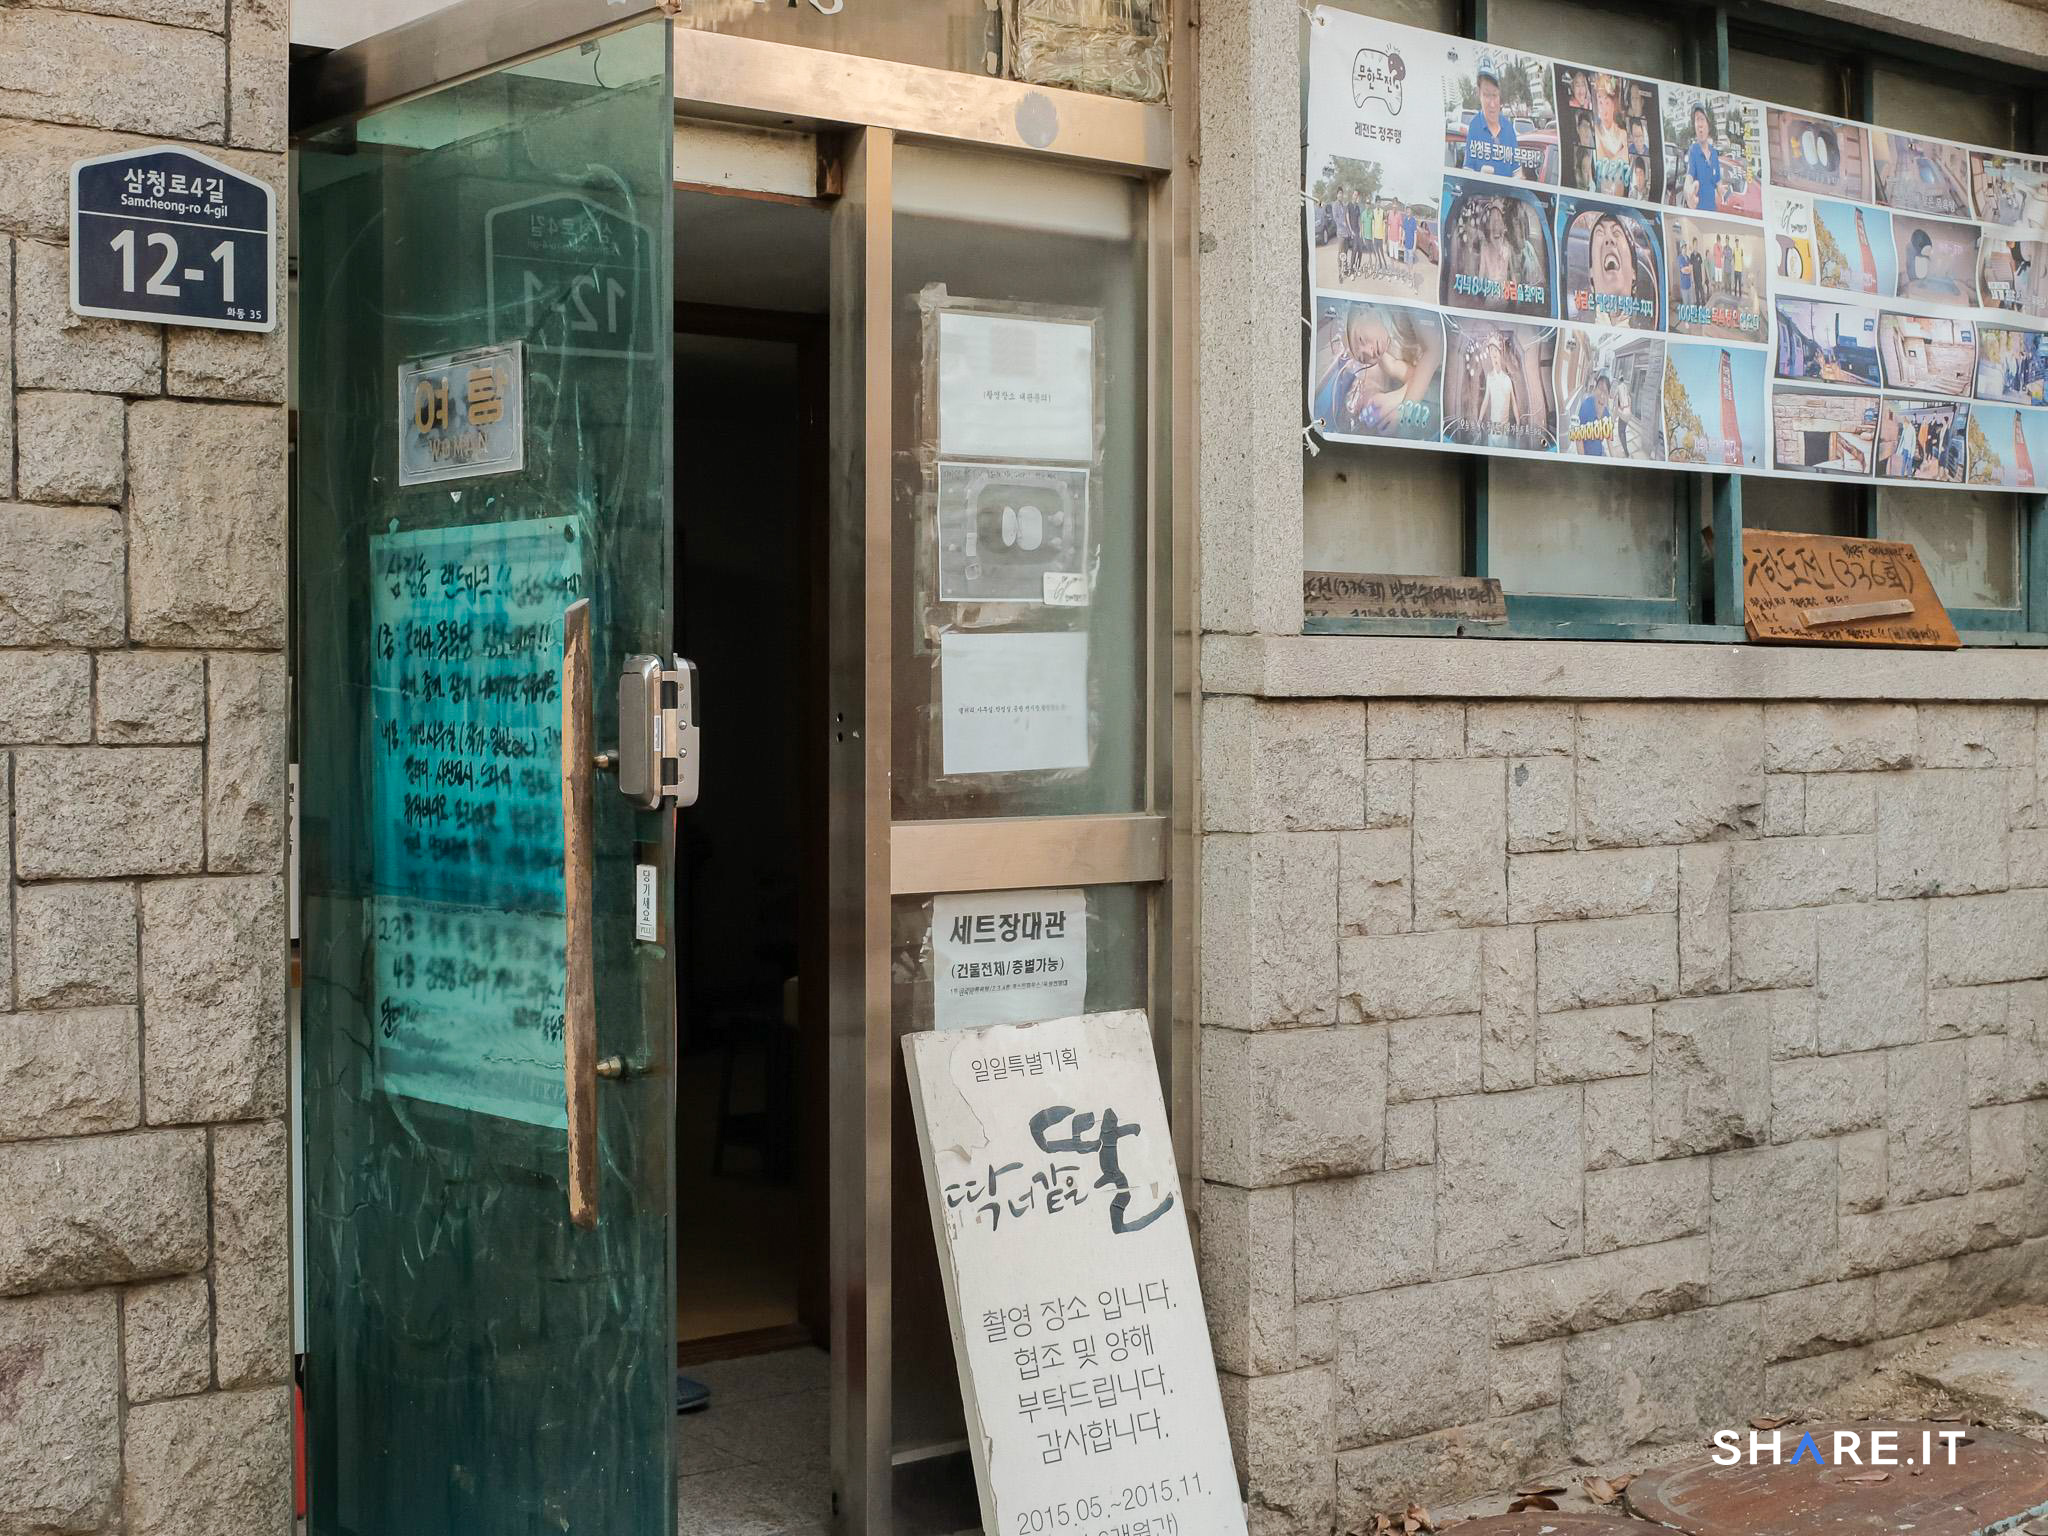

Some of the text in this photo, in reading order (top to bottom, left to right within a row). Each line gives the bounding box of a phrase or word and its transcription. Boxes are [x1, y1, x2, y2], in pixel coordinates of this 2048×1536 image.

[1354, 121, 1402, 145] 레전드 정주행
[1492, 145, 1513, 165] 코리아
[123, 168, 224, 204] 삼청로4길
[120, 193, 229, 218] Samcheong-ro 4-gil
[109, 229, 236, 303] 12-1
[226, 307, 262, 320] 화동 35
[642, 869, 651, 922] 당기세요
[949, 910, 1067, 945] 세트장대관
[951, 956, 1065, 980] (건물전체/층별가능)
[970, 1047, 1079, 1083] 일일특별기획
[982, 1278, 1177, 1343] 촬영 장소 입니다.
[1013, 1323, 1155, 1381] 협조 및 양해
[1018, 1363, 1174, 1424] 부탁드립니다.
[1037, 1407, 1170, 1465] 감사합니다.
[1016, 1471, 1212, 1536] 2015.05.~2015.11.
